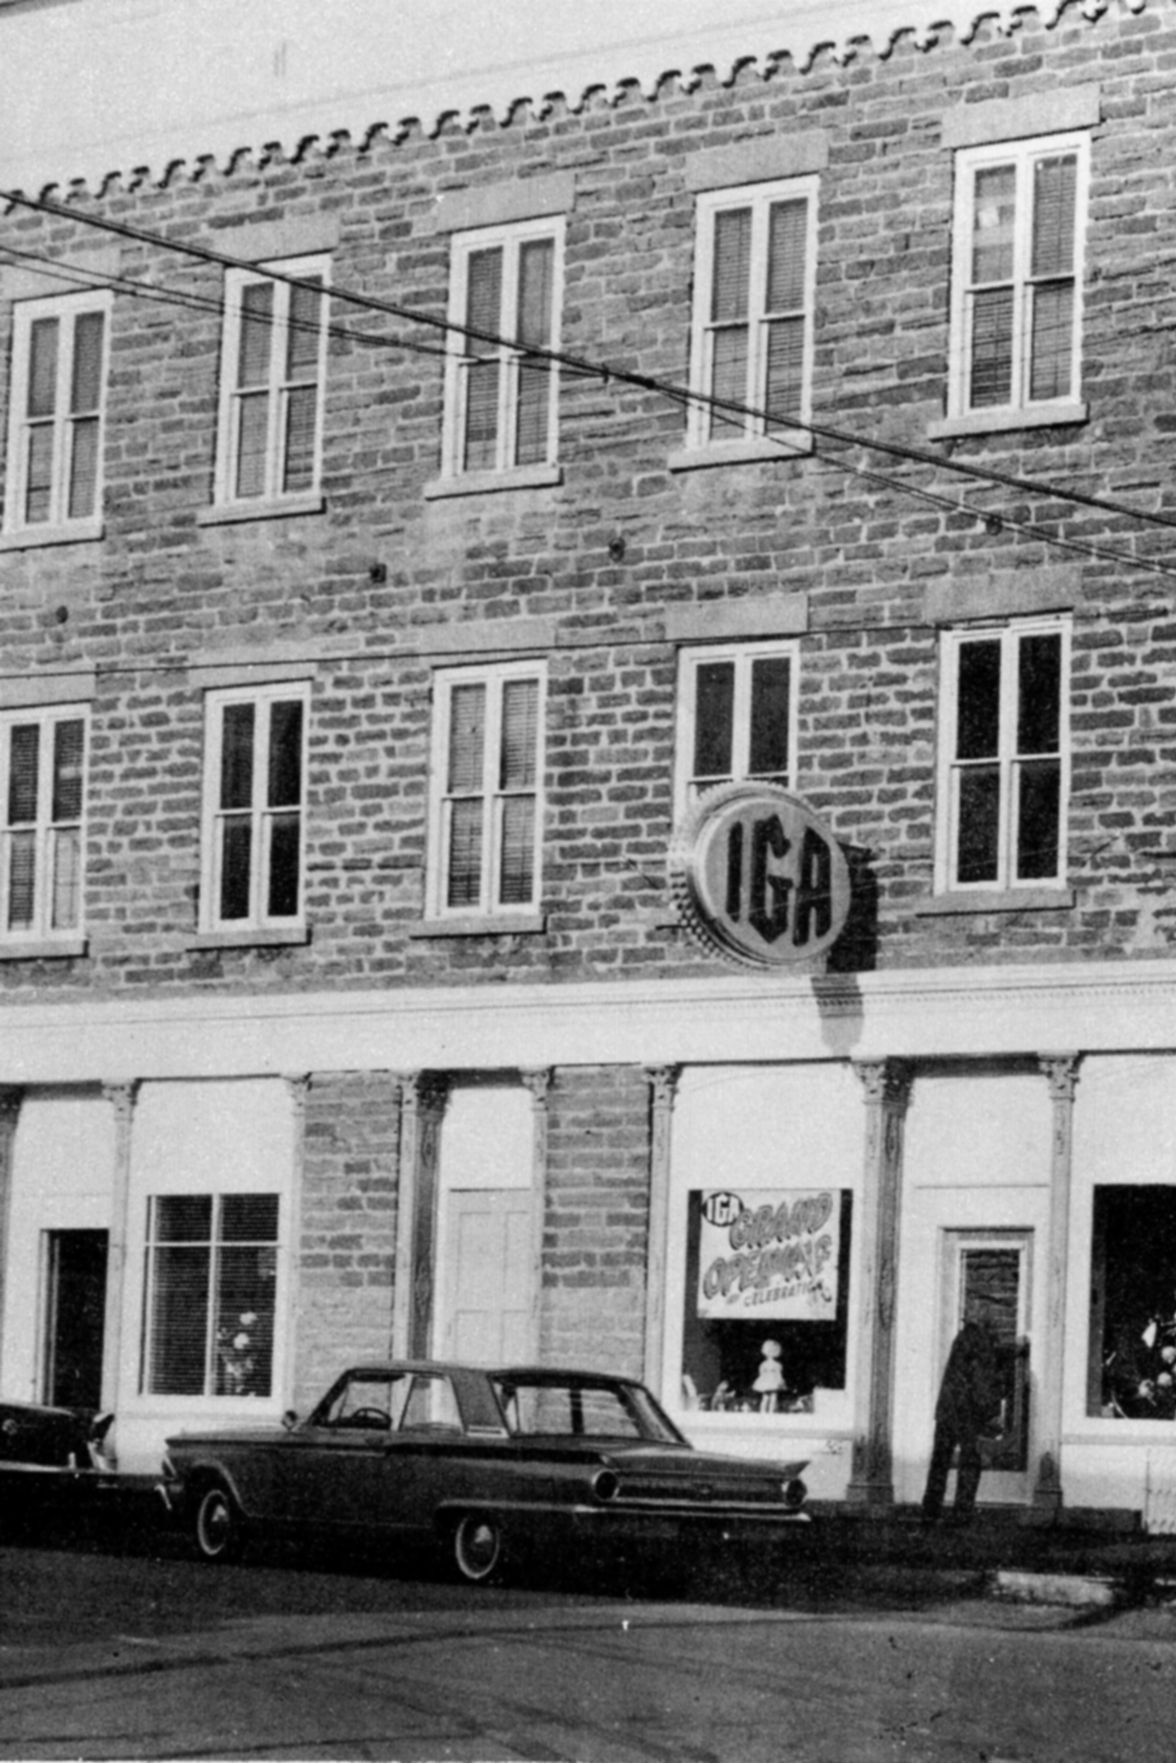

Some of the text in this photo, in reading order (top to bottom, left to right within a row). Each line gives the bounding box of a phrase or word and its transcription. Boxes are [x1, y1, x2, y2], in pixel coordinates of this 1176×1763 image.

[726, 813, 832, 947] IGA
[706, 1193, 741, 1225] IGA
[729, 1192, 833, 1251] GRAND
